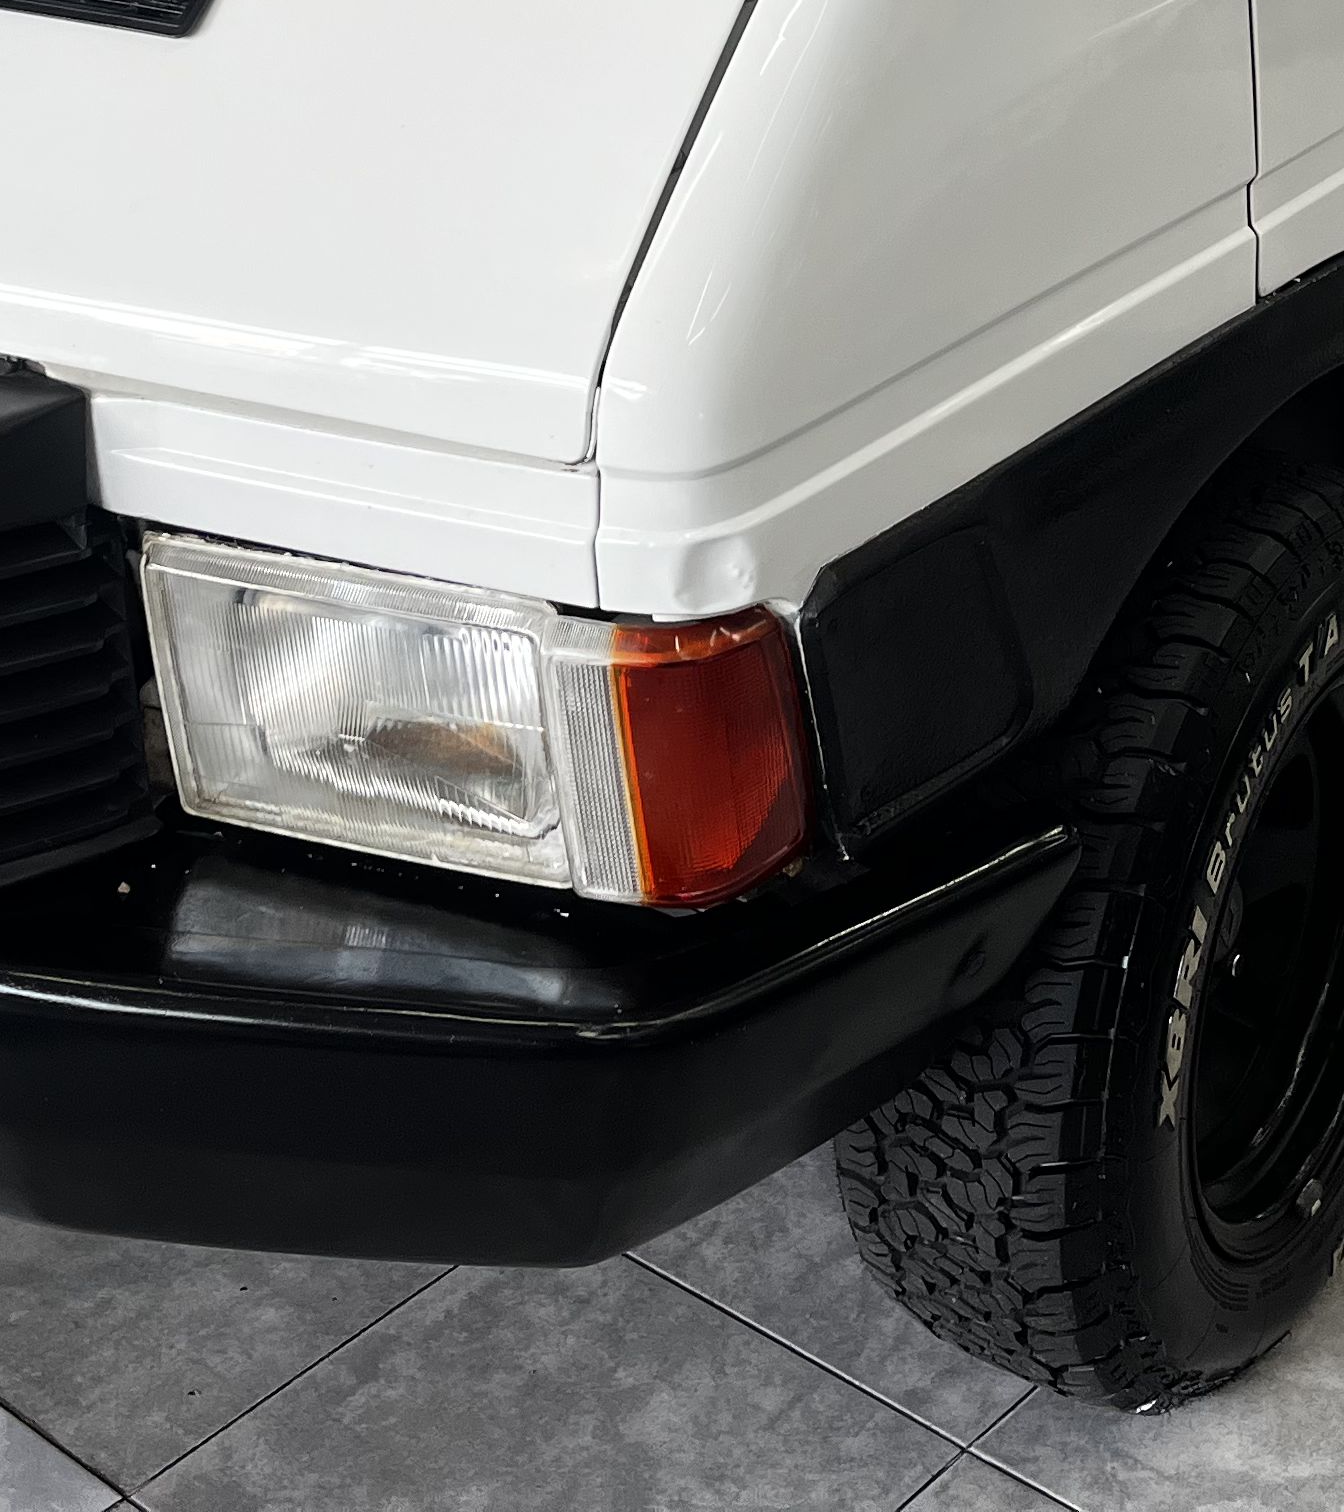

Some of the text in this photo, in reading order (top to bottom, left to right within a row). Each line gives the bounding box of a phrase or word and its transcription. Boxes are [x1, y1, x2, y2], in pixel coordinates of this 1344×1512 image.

[1158, 611, 1340, 1131] XBRI Brutus T/A
